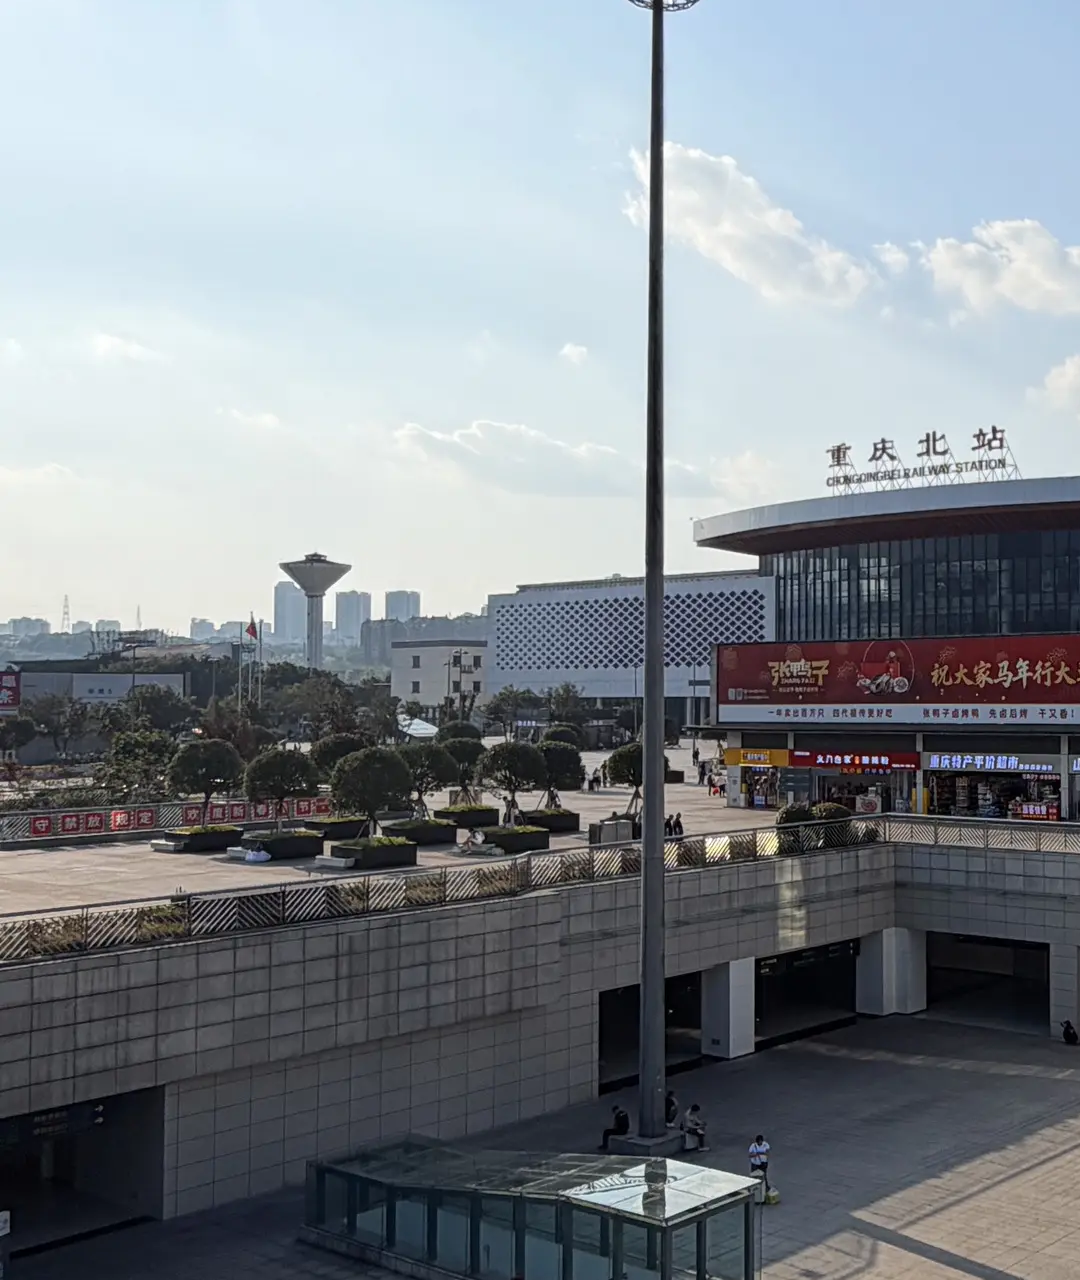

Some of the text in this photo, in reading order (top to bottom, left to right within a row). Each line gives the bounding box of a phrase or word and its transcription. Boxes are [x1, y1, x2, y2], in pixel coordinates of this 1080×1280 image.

[826, 425, 1005, 468] 重庆北站
[904, 464, 952, 479] RAILWAY
[955, 458, 1006, 473] STATION
[768, 658, 830, 686] 张鸭子
[929, 754, 1019, 770] 重庆特产平价超市
